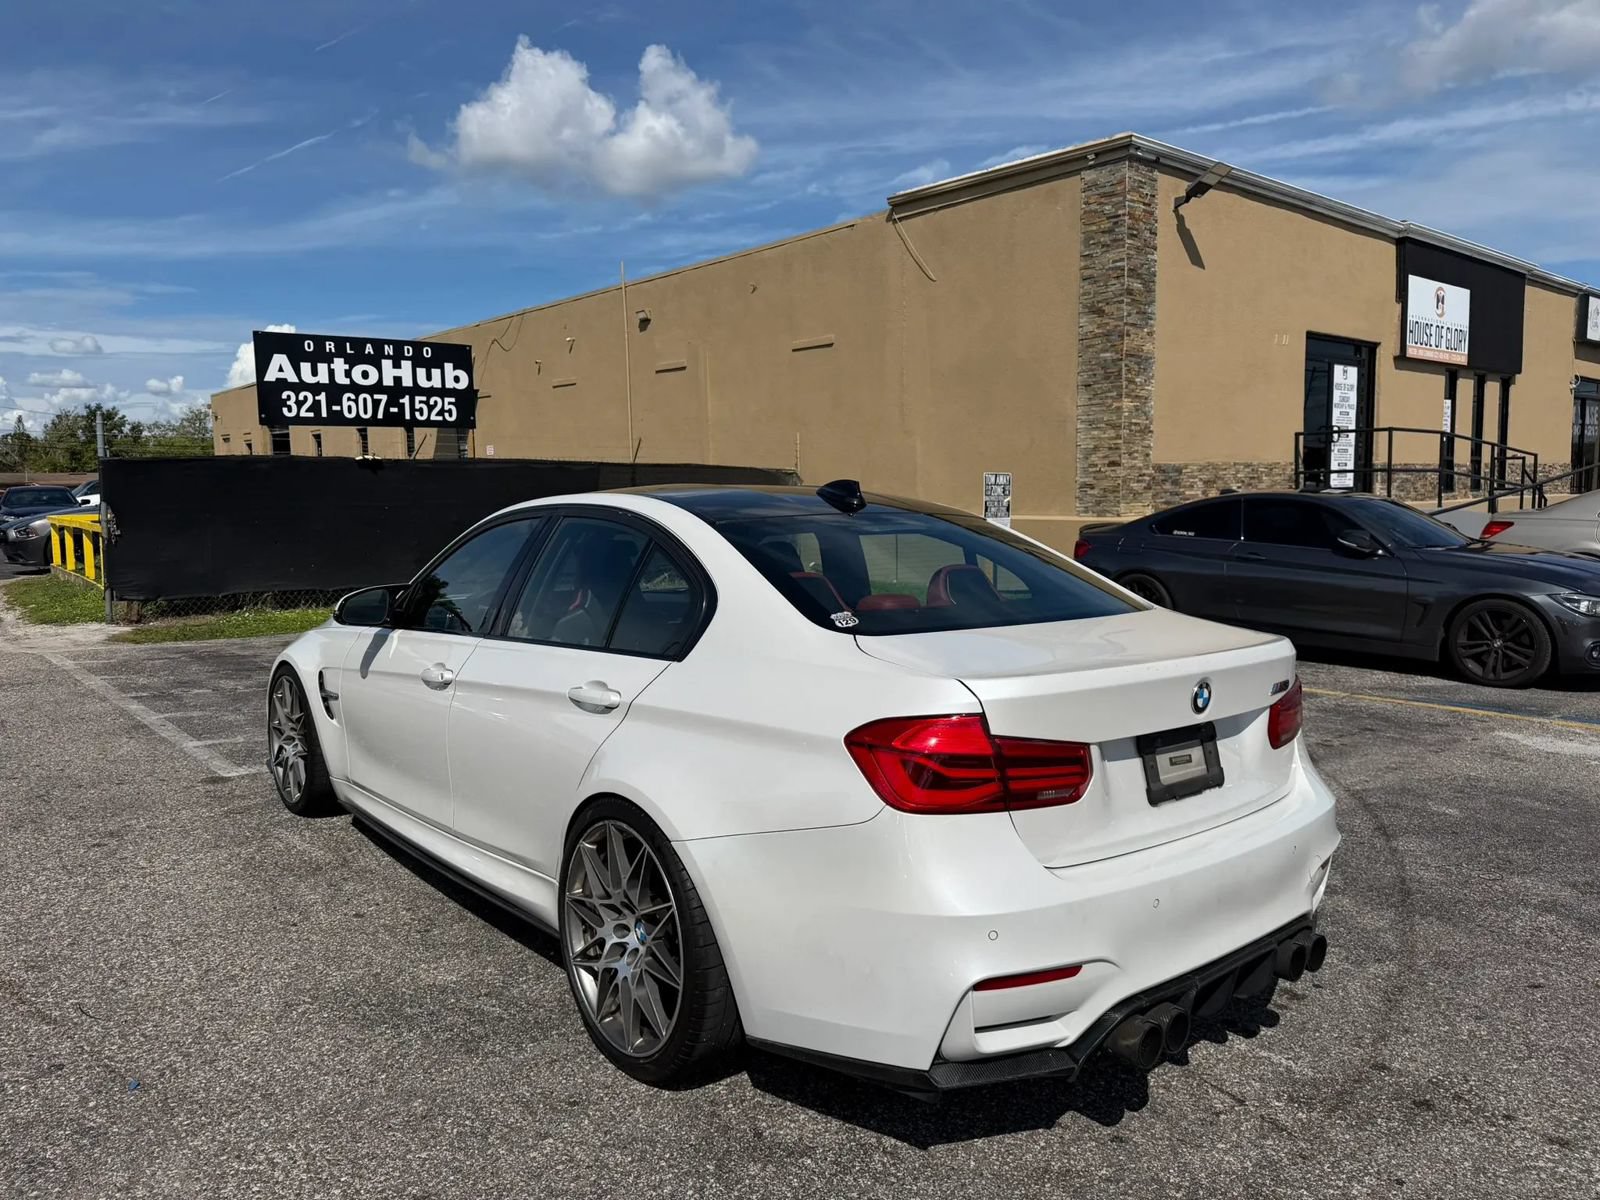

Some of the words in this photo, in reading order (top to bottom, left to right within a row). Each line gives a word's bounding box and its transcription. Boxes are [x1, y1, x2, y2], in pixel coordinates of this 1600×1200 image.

[304, 340, 432, 358] ORLANDO
[1408, 319, 1433, 347] HOUSE
[1435, 324, 1444, 349] OF
[1445, 327, 1468, 353] GLORY
[263, 353, 469, 390] AutoHub
[281, 390, 458, 422] 321-607-1525
